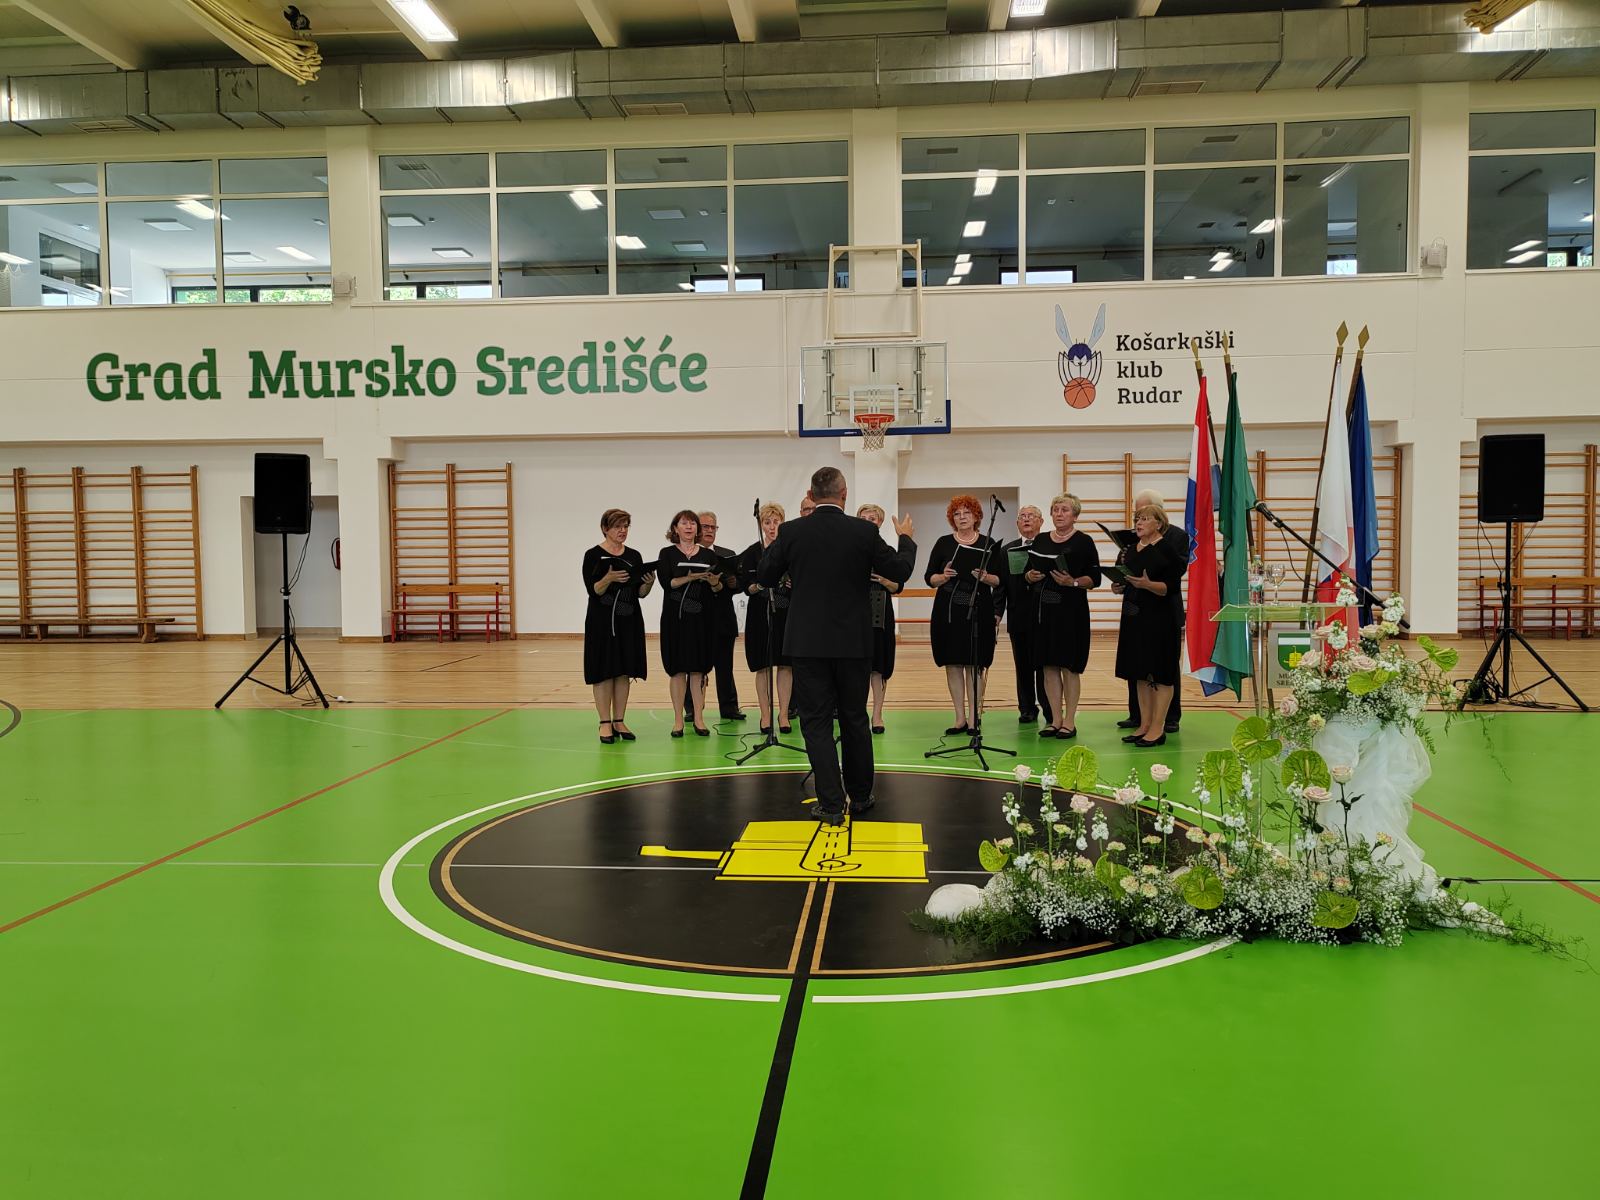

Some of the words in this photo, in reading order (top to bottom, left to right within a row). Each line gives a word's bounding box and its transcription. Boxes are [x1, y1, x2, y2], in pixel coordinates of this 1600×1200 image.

[86, 348, 221, 401] Grad
[248, 345, 456, 398] Mursko
[476, 335, 707, 396] Središće
[1117, 360, 1163, 379] klub
[1117, 386, 1183, 405] Rudar
